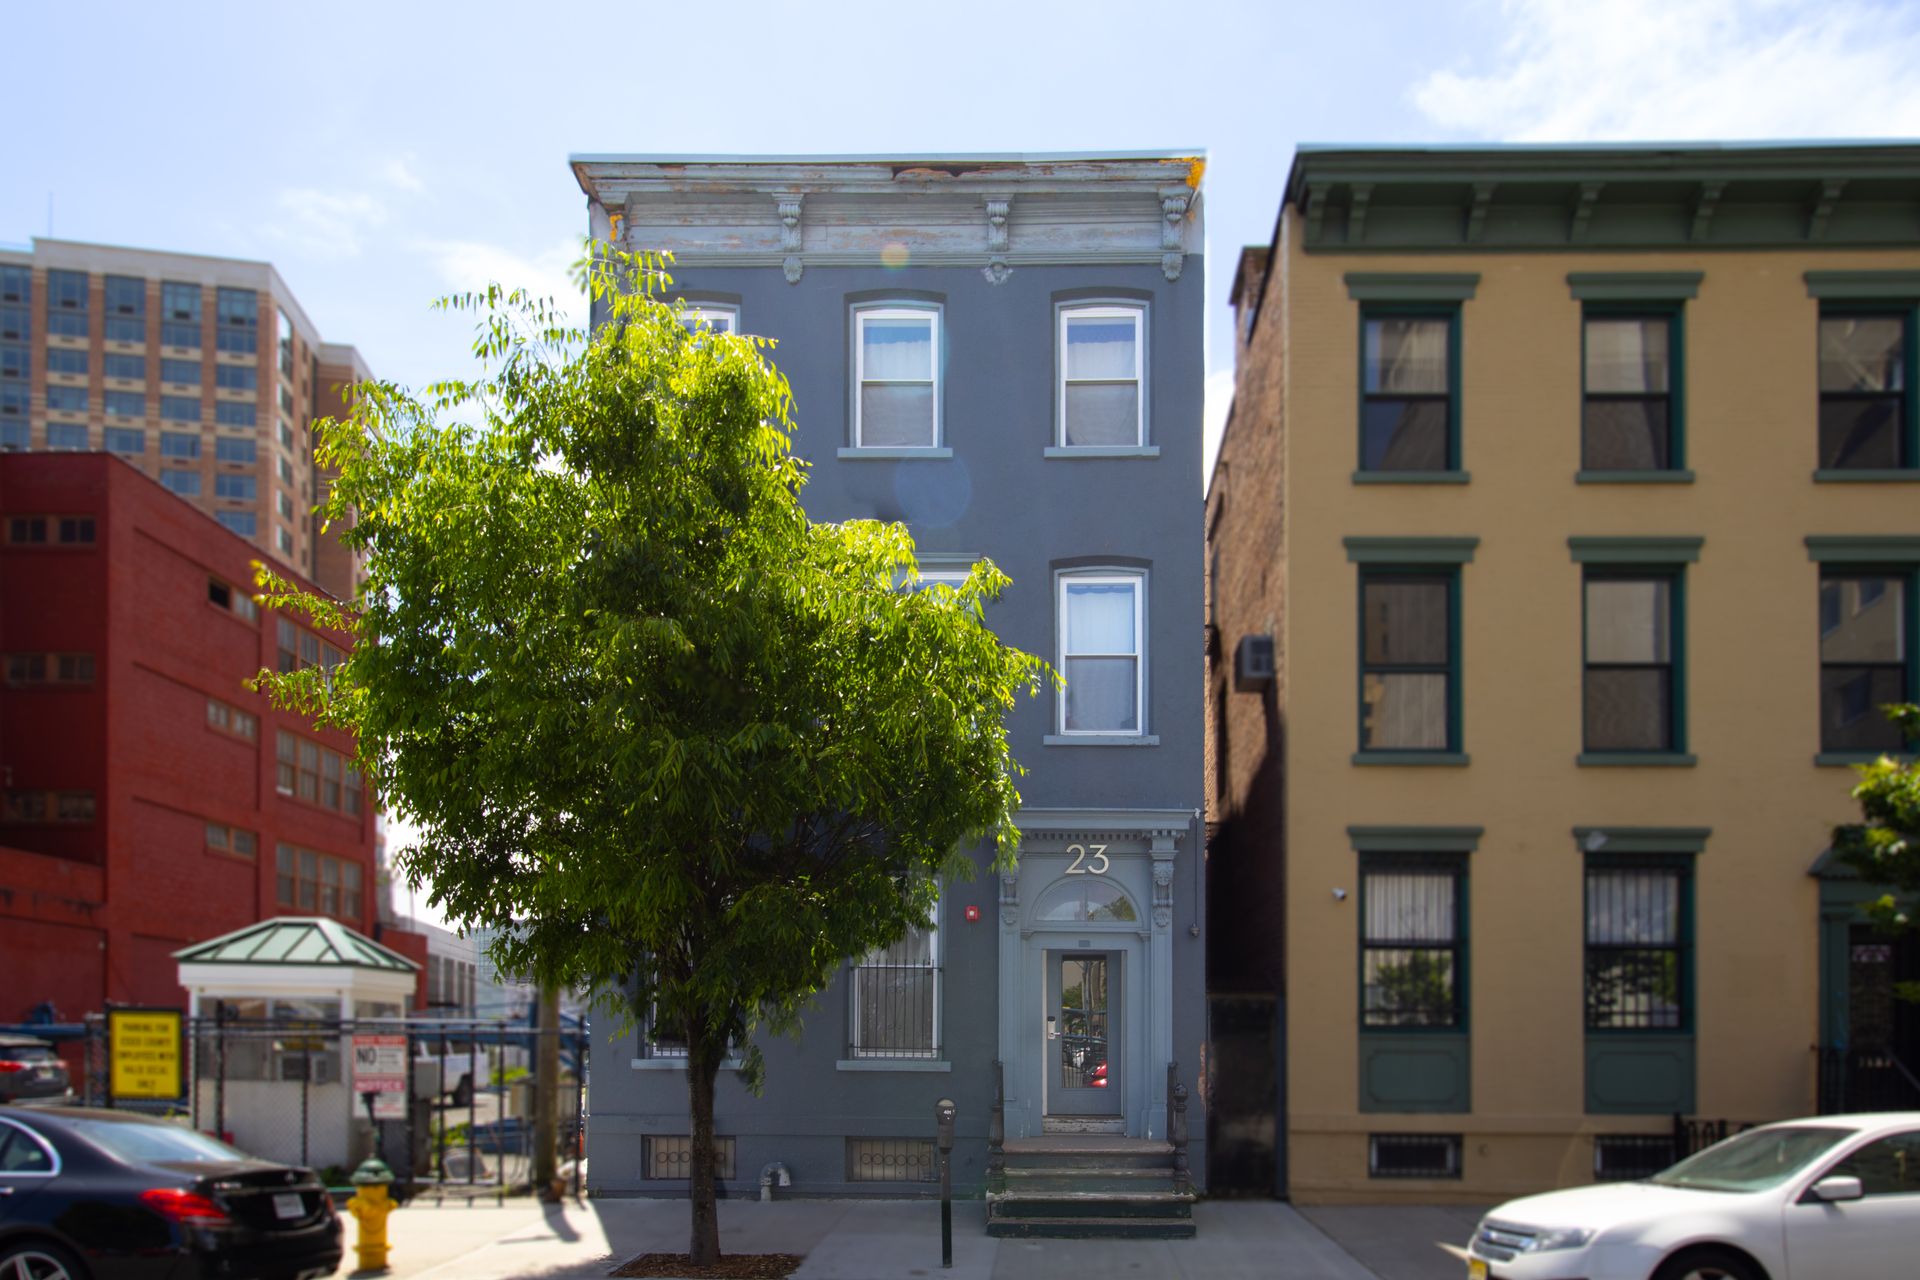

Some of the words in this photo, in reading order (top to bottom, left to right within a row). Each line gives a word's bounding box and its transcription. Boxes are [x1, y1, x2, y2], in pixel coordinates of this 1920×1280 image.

[1065, 844, 1109, 874] 23
[356, 1047, 377, 1065] NO
[356, 1081, 404, 1091] NOTICE
